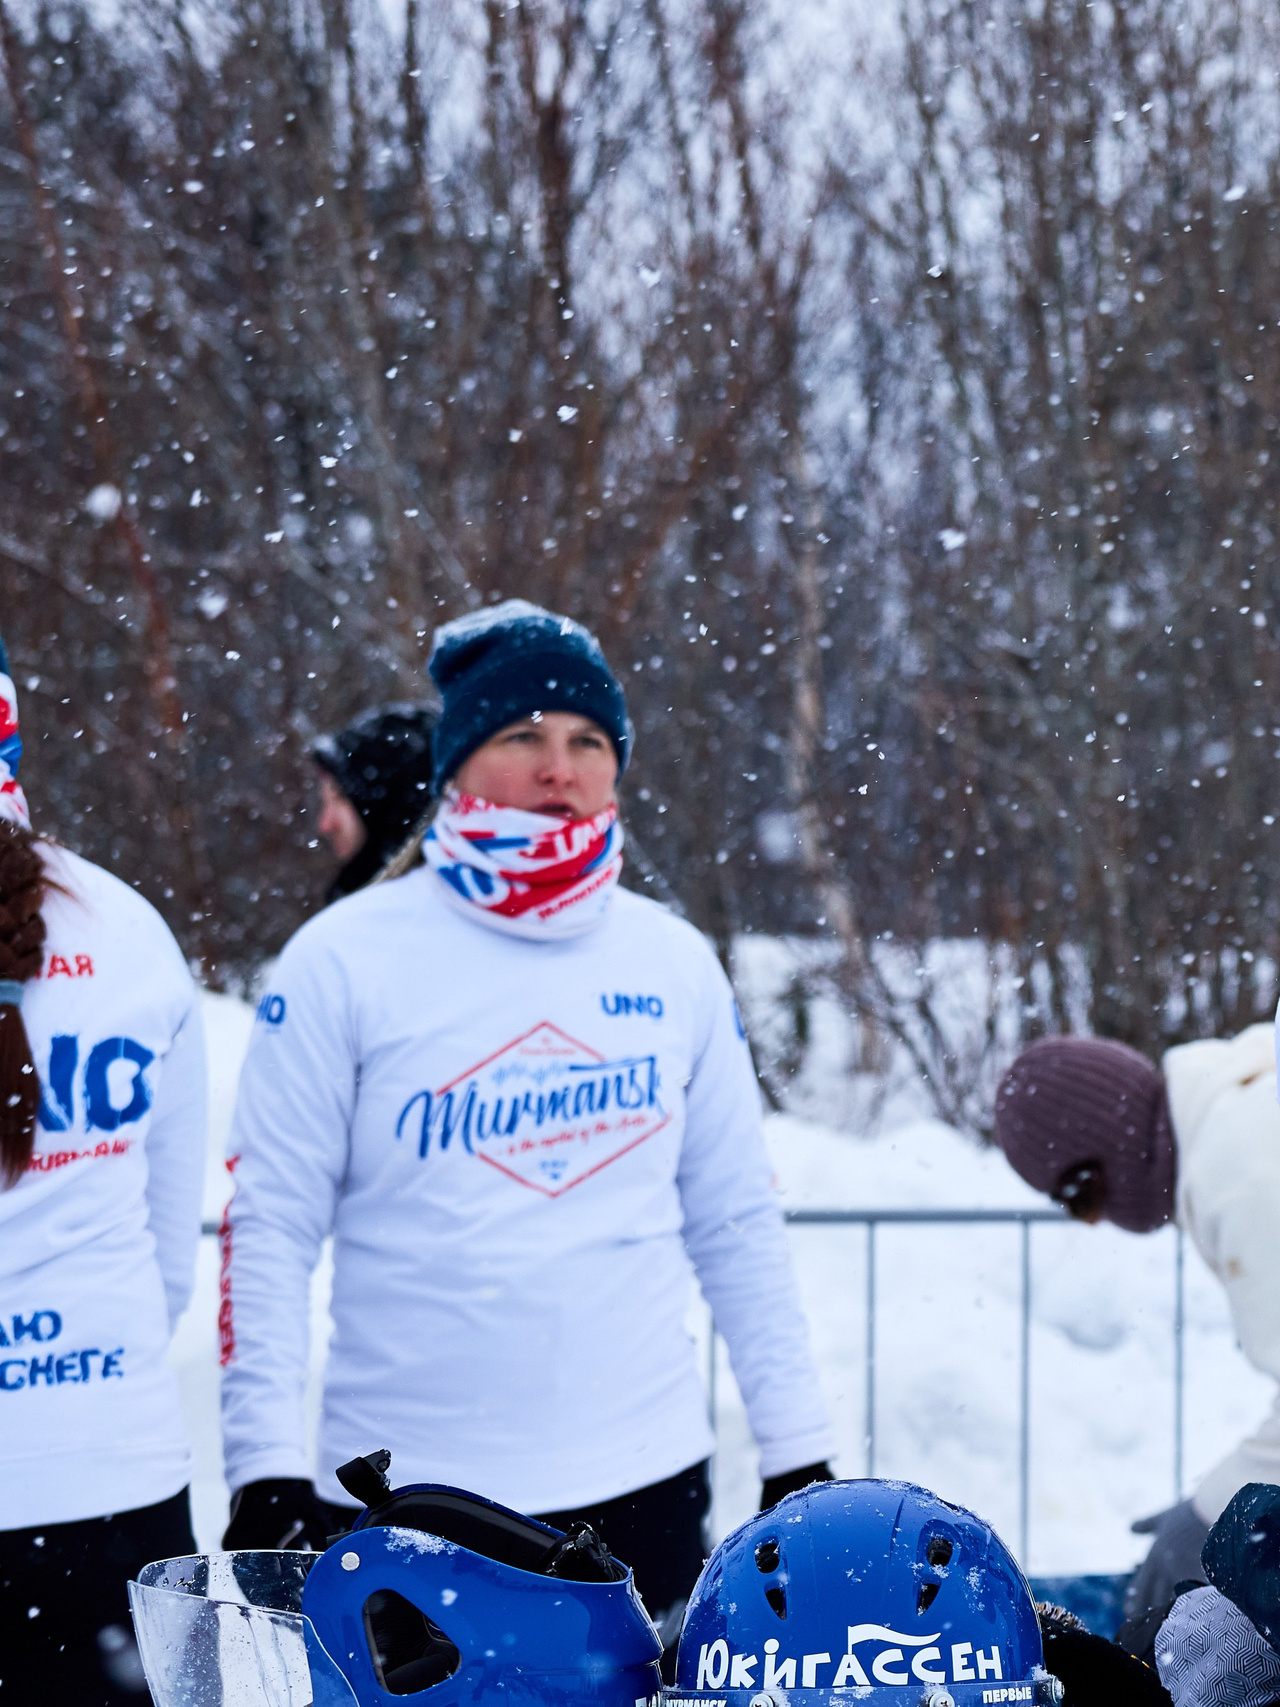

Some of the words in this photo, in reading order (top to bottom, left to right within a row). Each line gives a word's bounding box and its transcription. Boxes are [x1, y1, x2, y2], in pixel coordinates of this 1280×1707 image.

[601, 993, 664, 1019] UNO
[394, 1054, 669, 1160] Murmansk
[982, 1686, 1033, 1704] ПЕРВЫЕ
